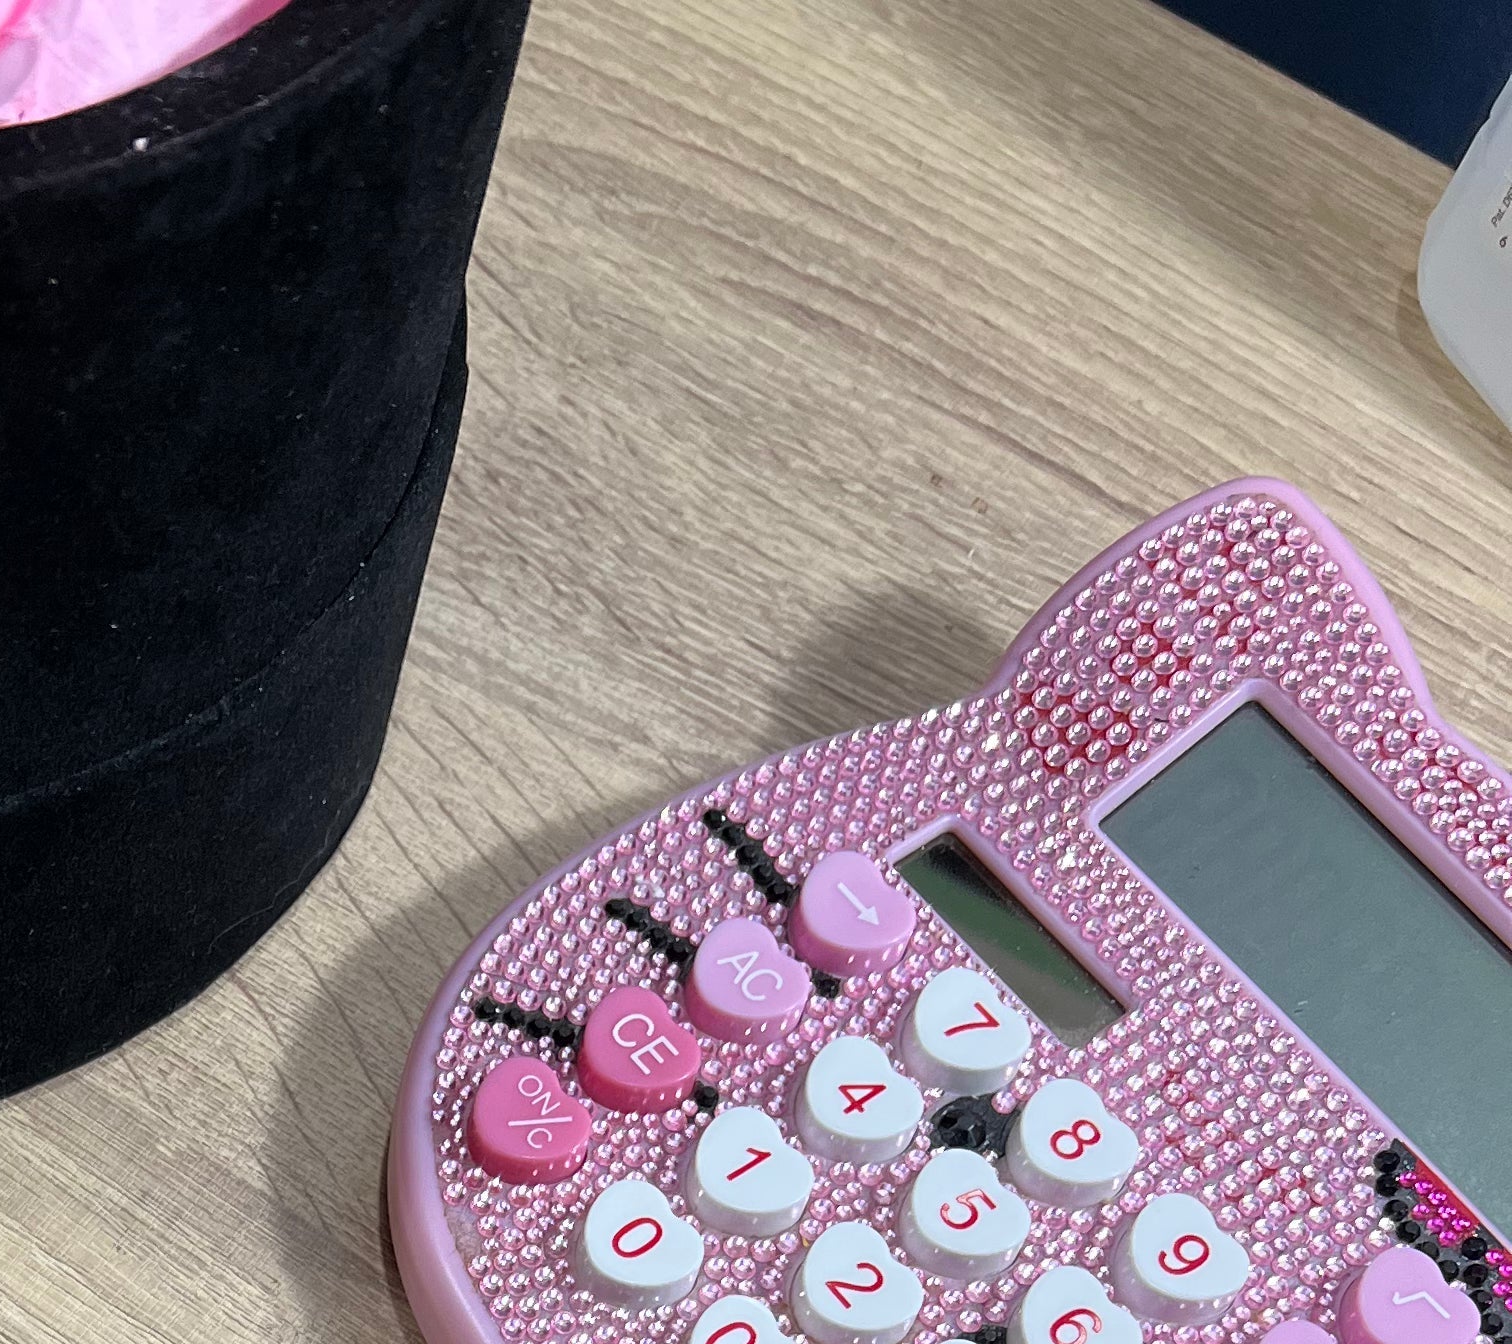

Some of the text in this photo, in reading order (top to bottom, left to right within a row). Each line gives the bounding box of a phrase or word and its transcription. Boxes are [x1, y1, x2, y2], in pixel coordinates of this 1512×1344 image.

[717, 951, 783, 1002] AC
[945, 1003, 1000, 1037] 7
[611, 1013, 679, 1075] CE
[839, 1084, 886, 1115] 4
[1049, 1119, 1102, 1161] 8
[727, 1148, 771, 1182] 1
[940, 1192, 996, 1231] 5
[611, 1217, 664, 1260] 0
[1157, 1234, 1211, 1276] 9
[826, 1262, 885, 1310] 2
